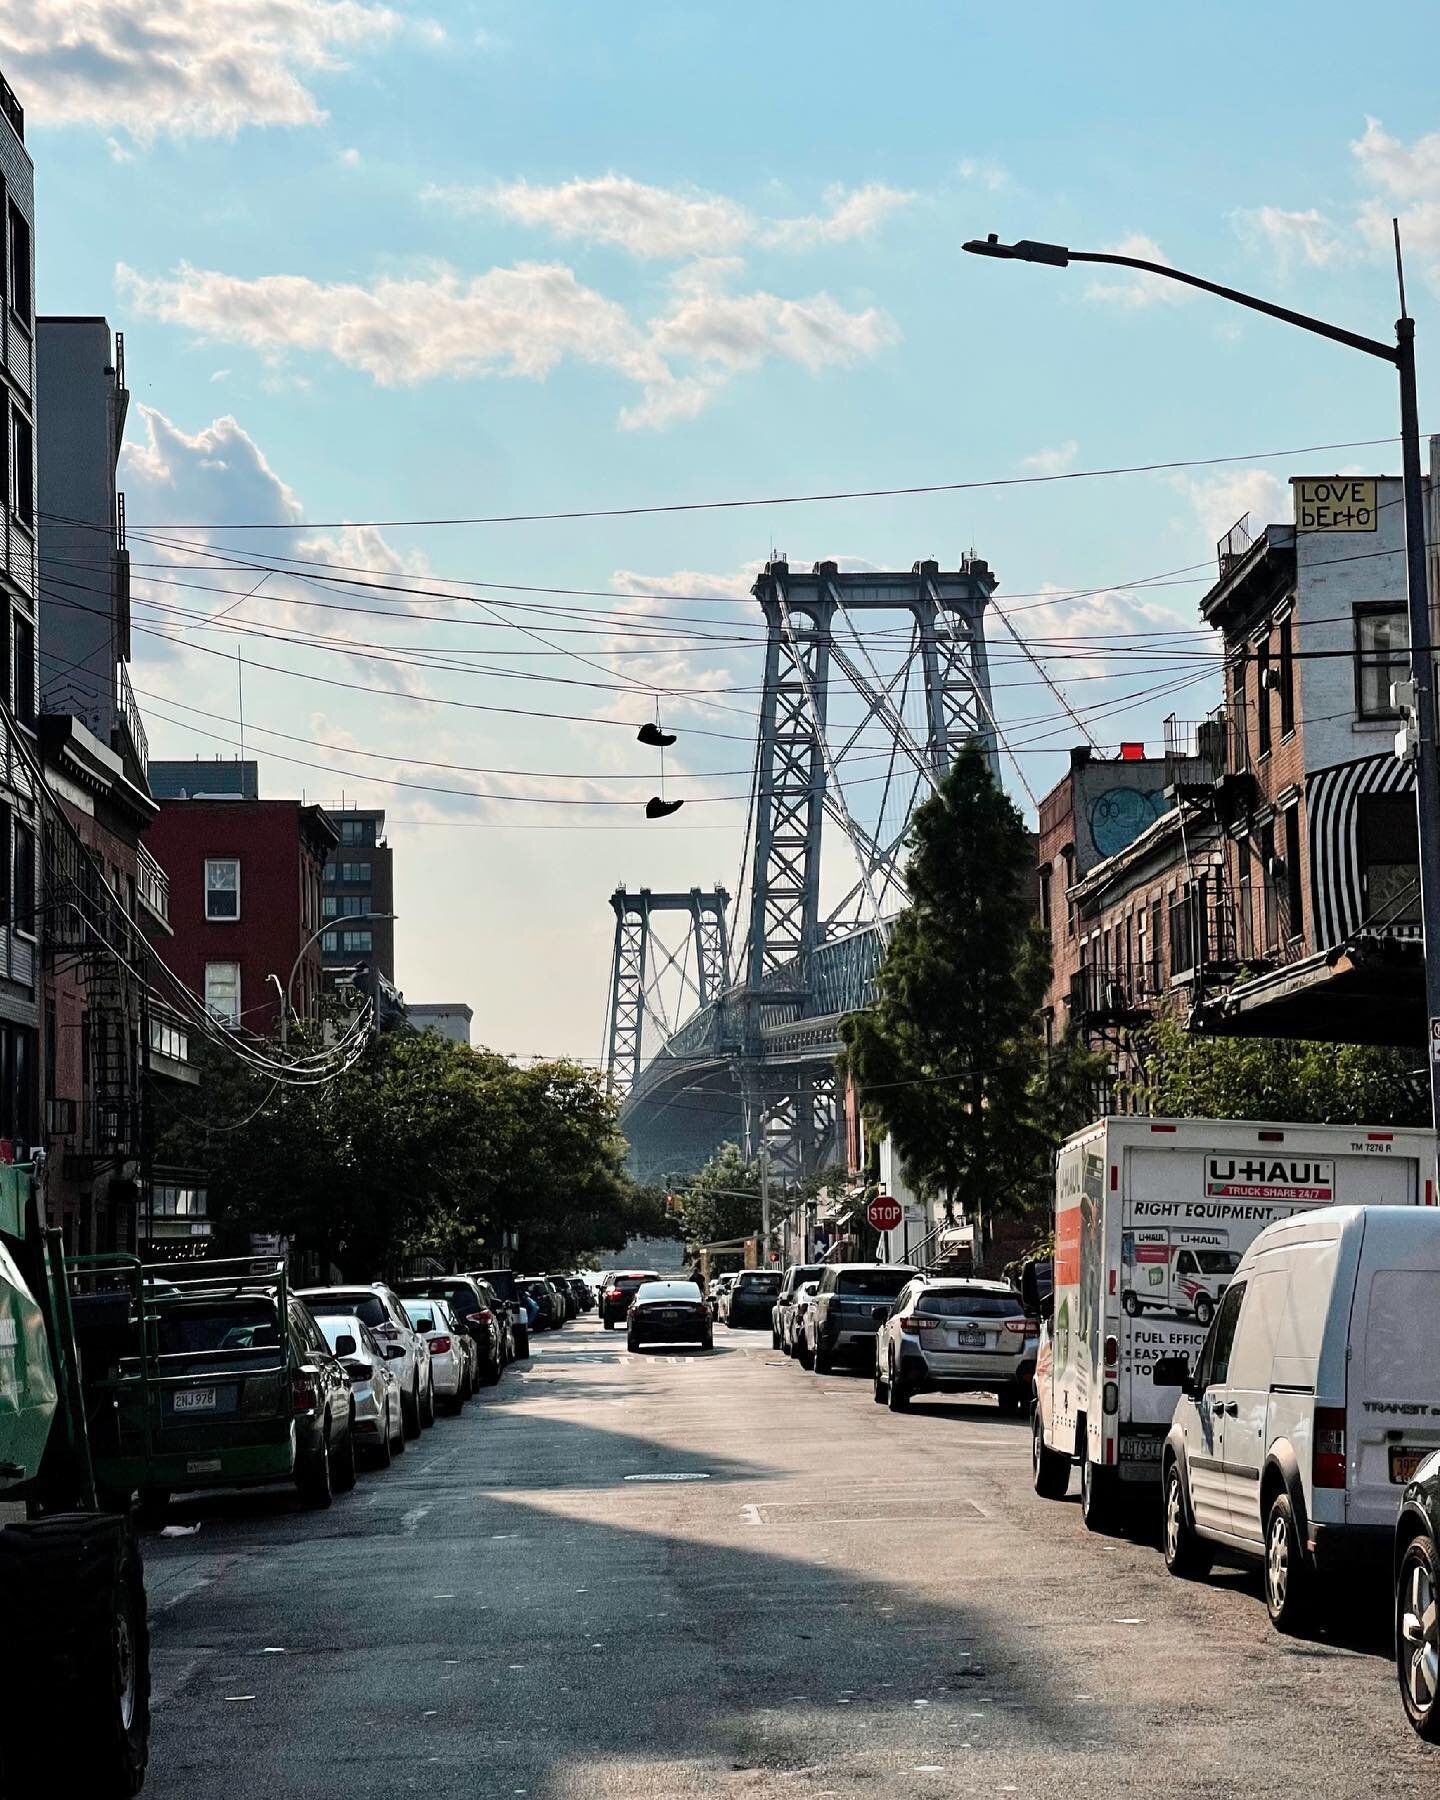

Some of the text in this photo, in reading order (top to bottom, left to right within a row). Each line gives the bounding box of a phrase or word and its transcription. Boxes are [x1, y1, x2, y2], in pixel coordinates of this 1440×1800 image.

[1301, 482, 1365, 503] LOVE
[1350, 1142, 1363, 1152] TM
[1210, 1160, 1330, 1184] U-HAUL
[1228, 1186, 1320, 1199] TRUCK SHARE 24/7
[870, 1207, 900, 1220] STOP
[1134, 1202, 1180, 1216] RIGHT
[1138, 1233, 1165, 1242] U-HAUL
[1180, 1234, 1221, 1245] U-HAUL
[1135, 1332, 1165, 1344] FUEL
[1134, 1348, 1168, 1360] EASY
[1172, 1350, 1190, 1358] TO
[1134, 1365, 1153, 1375] TO
[1362, 1401, 1429, 1415] TRANSIT
